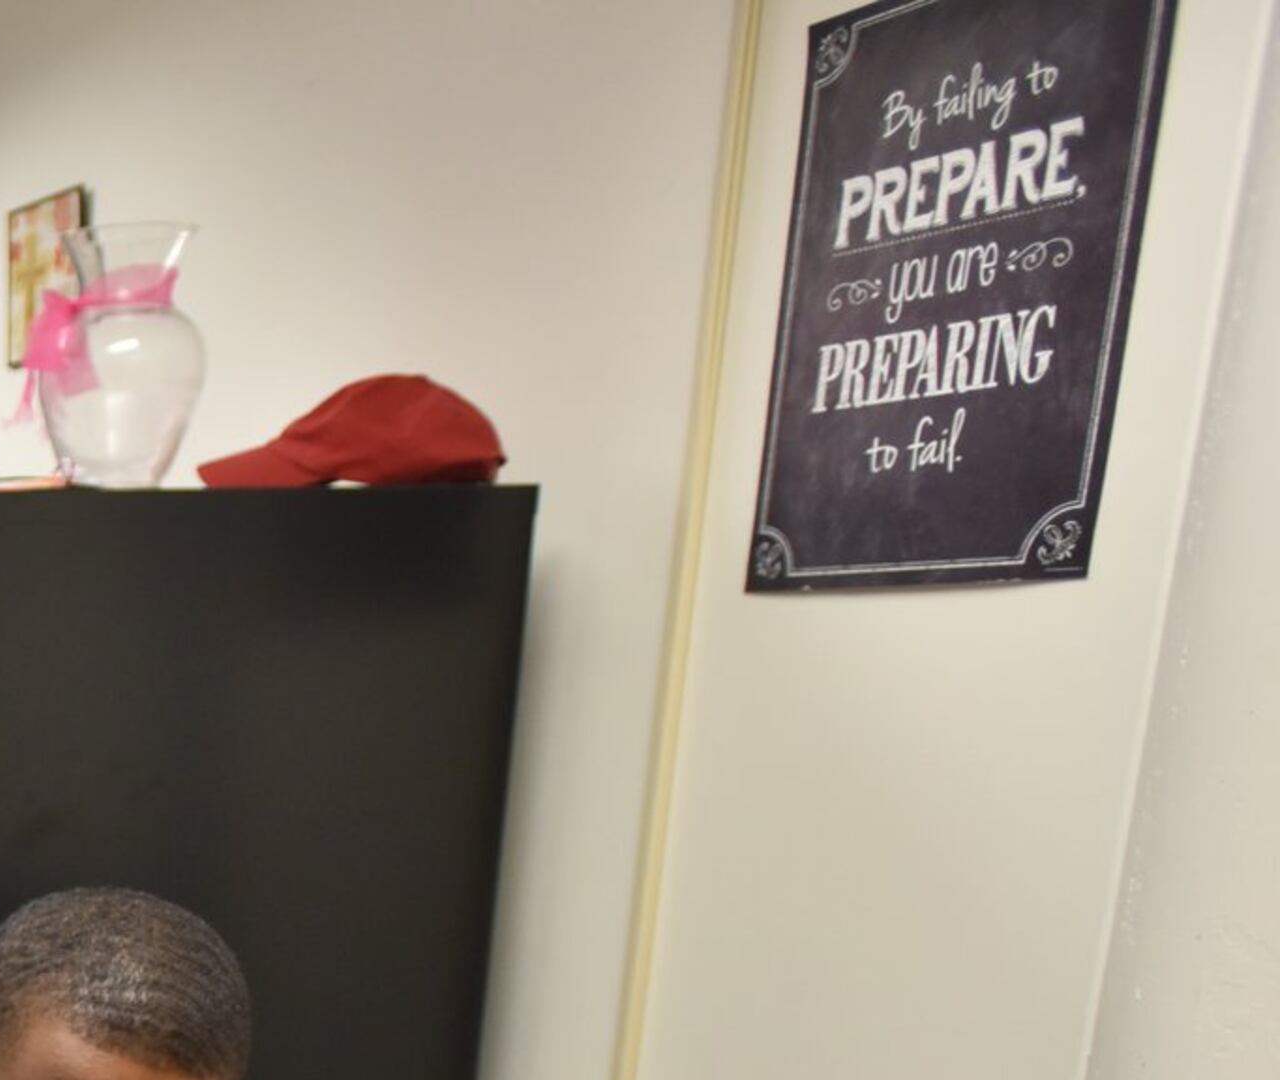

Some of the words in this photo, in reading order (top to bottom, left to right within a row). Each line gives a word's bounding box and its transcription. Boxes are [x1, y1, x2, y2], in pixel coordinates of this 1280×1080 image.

[882, 89, 926, 149] By
[935, 62, 1018, 130] failing
[1026, 60, 1058, 95] to
[834, 116, 1087, 250] PREPARE,
[885, 258, 936, 324] you
[947, 241, 999, 297] are
[812, 305, 1057, 414] PREPARING
[866, 438, 898, 473] to
[908, 408, 967, 472] fail.
